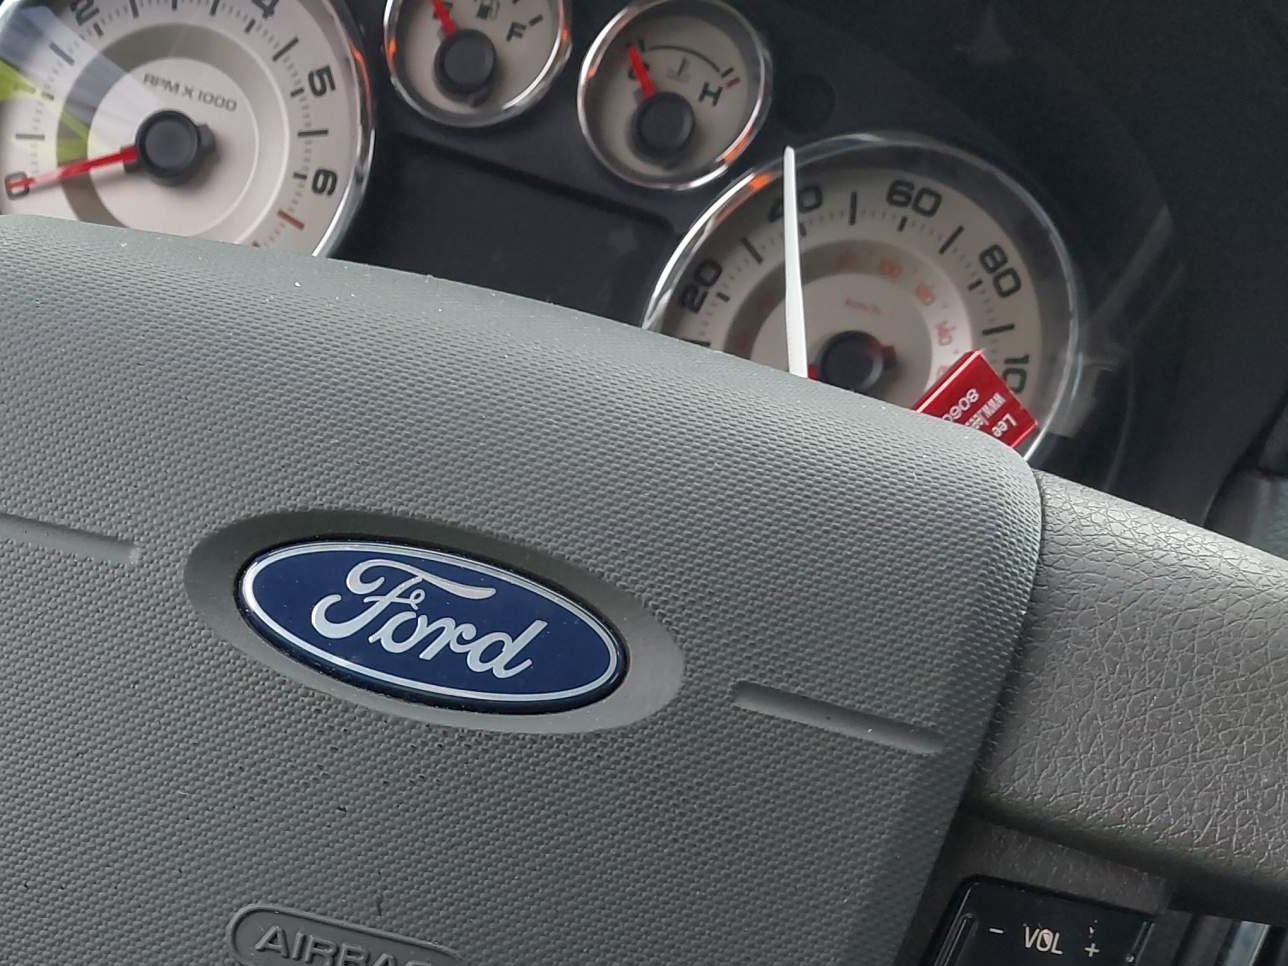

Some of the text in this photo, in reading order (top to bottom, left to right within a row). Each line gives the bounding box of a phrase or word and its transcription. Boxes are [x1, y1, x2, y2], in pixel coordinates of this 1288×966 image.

[143, 72, 180, 95] RPM
[198, 90, 237, 112] 1000
[307, 65, 336, 97] 5
[698, 81, 723, 106] H
[311, 169, 338, 196] 6
[886, 179, 942, 218] 60
[680, 259, 722, 314] 20
[978, 244, 1021, 298] 80
[992, 413, 1017, 437] Lee
[311, 558, 548, 679] Ford
[1023, 926, 1063, 956] VOL
